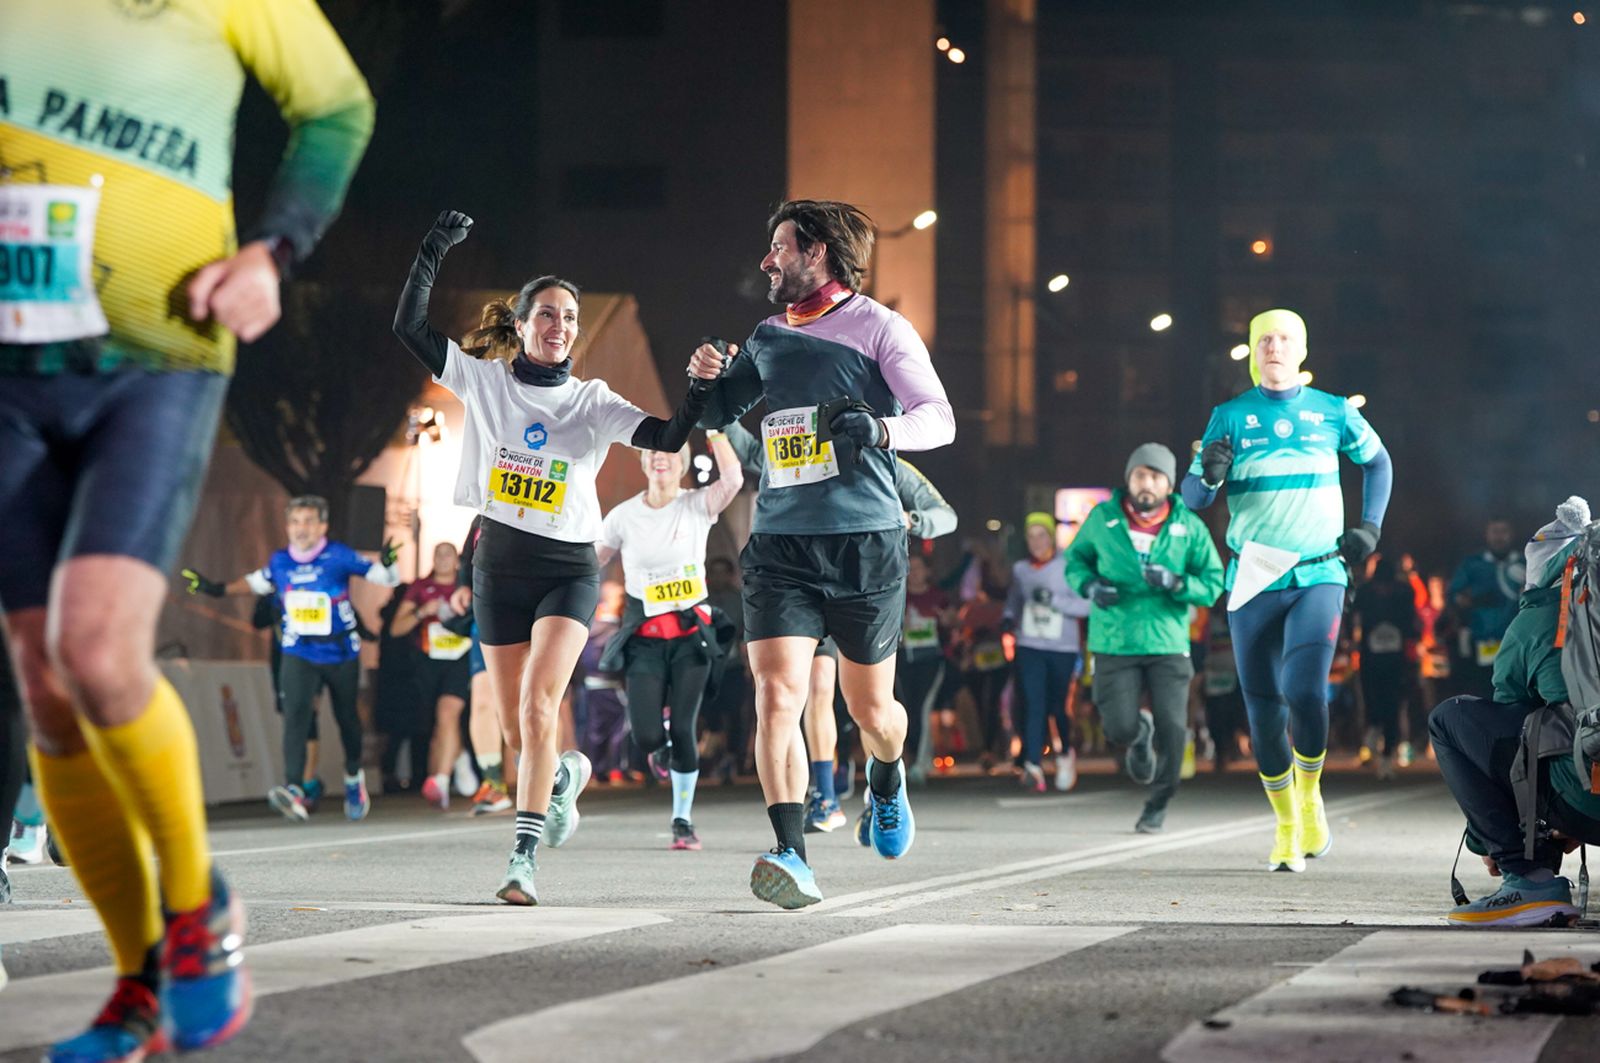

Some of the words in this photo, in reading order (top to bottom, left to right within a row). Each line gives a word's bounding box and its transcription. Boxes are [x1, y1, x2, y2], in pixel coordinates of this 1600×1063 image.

[37, 86, 198, 179] PANDERA
[497, 460, 513, 471] SAN
[508, 453, 533, 464] NOCHE
[533, 457, 544, 467] DE
[500, 472, 556, 504] 13112
[655, 580, 692, 600] 3120
[1486, 891, 1522, 908] HOKA
